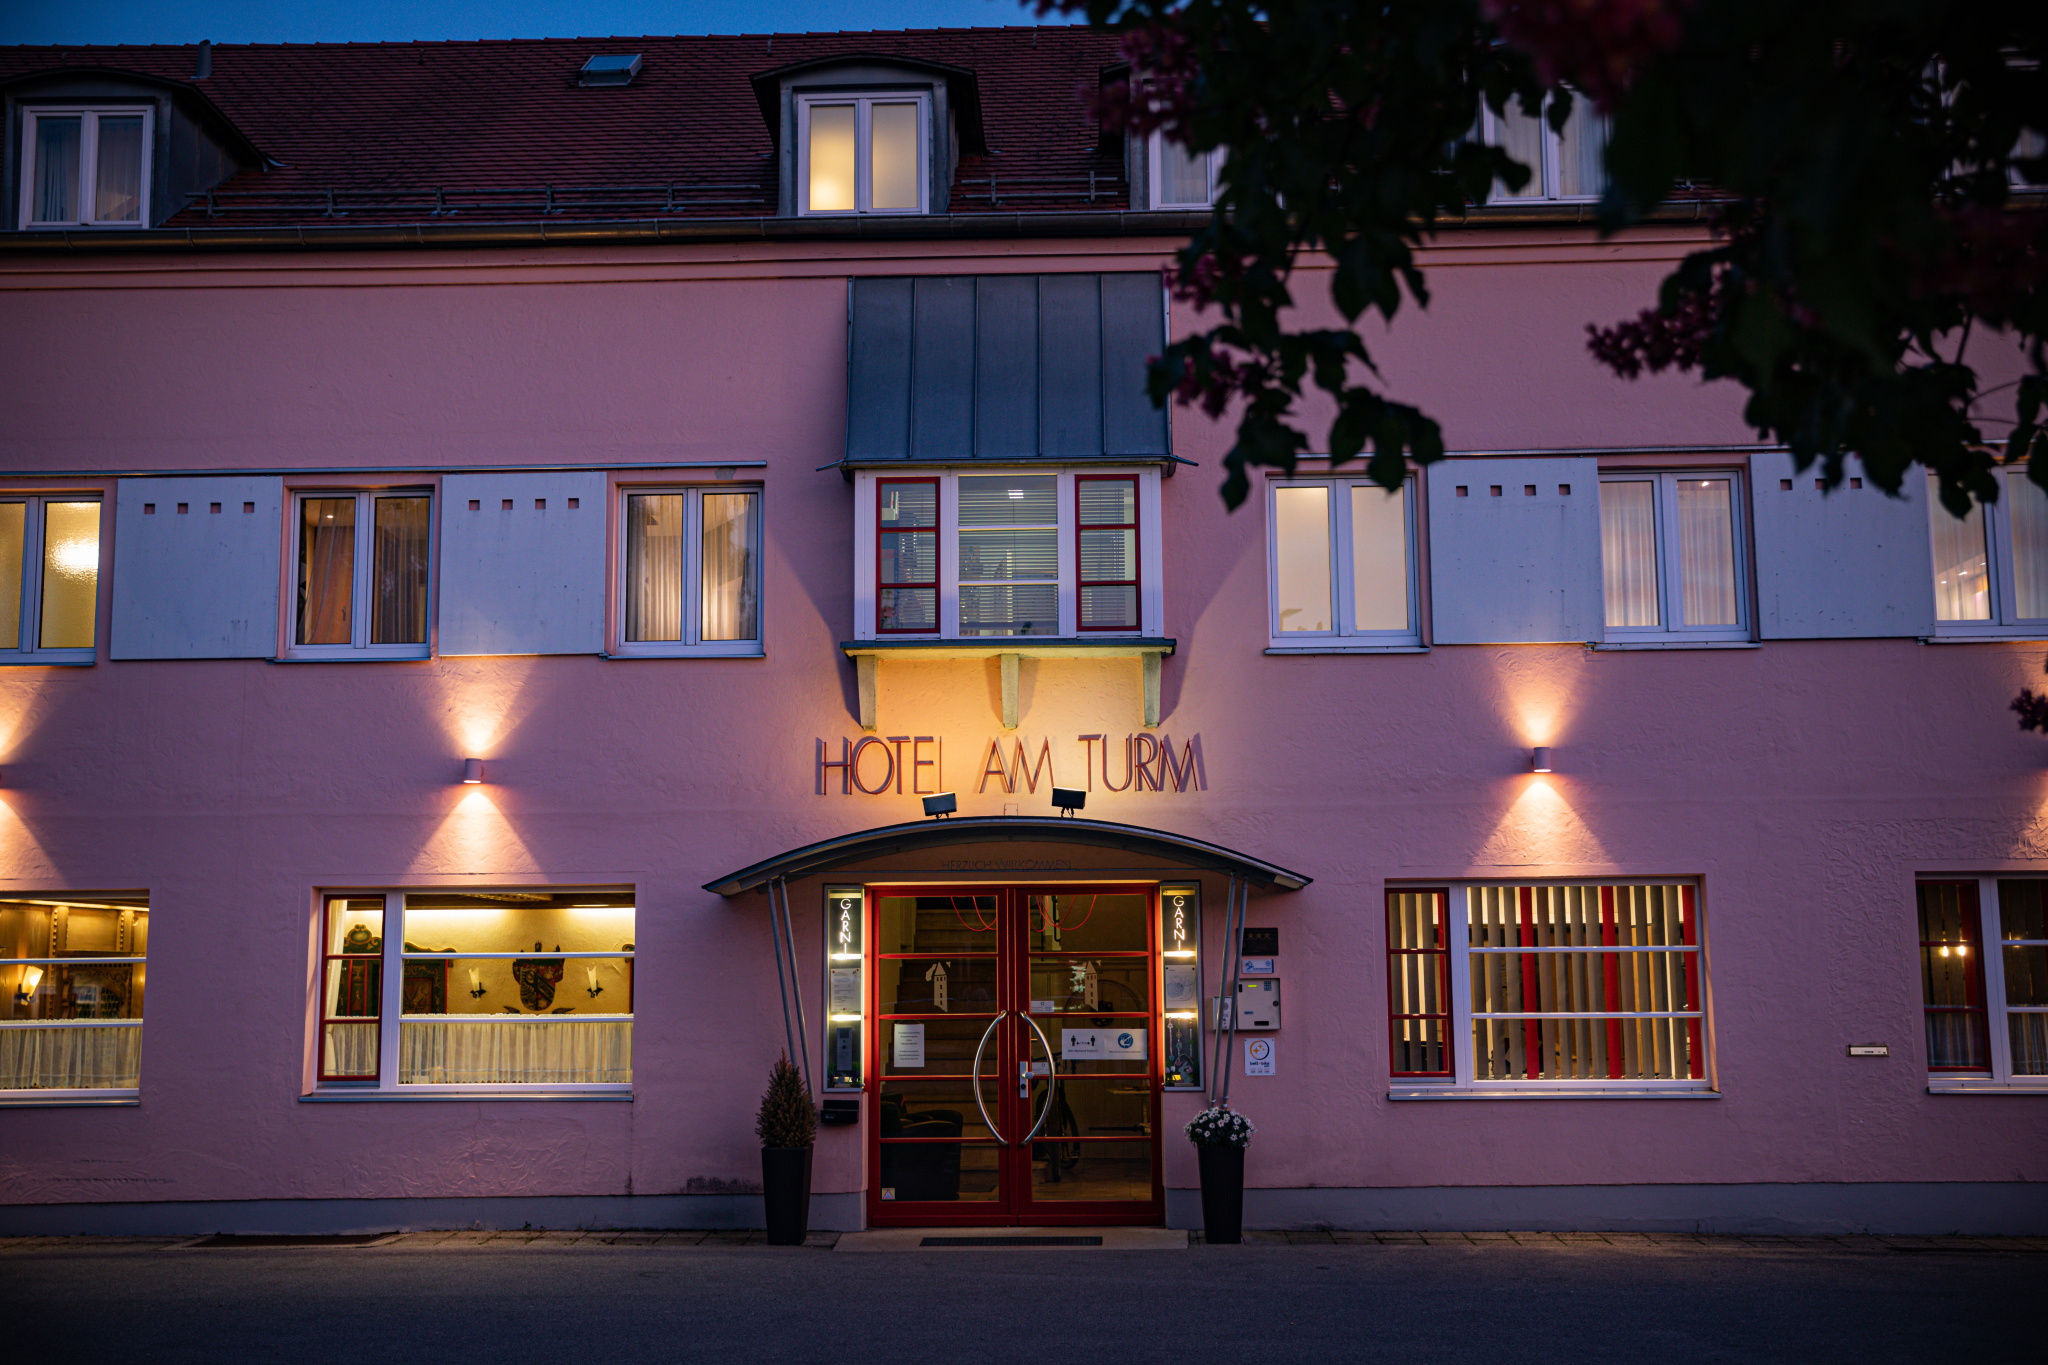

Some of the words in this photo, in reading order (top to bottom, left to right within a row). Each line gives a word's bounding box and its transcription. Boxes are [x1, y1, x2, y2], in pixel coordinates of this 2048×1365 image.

[822, 738, 944, 796] HOTEL
[979, 739, 1055, 794] AM
[1077, 735, 1200, 793] TURM
[840, 898, 852, 954] GARNI
[1173, 895, 1186, 951] GARNI
